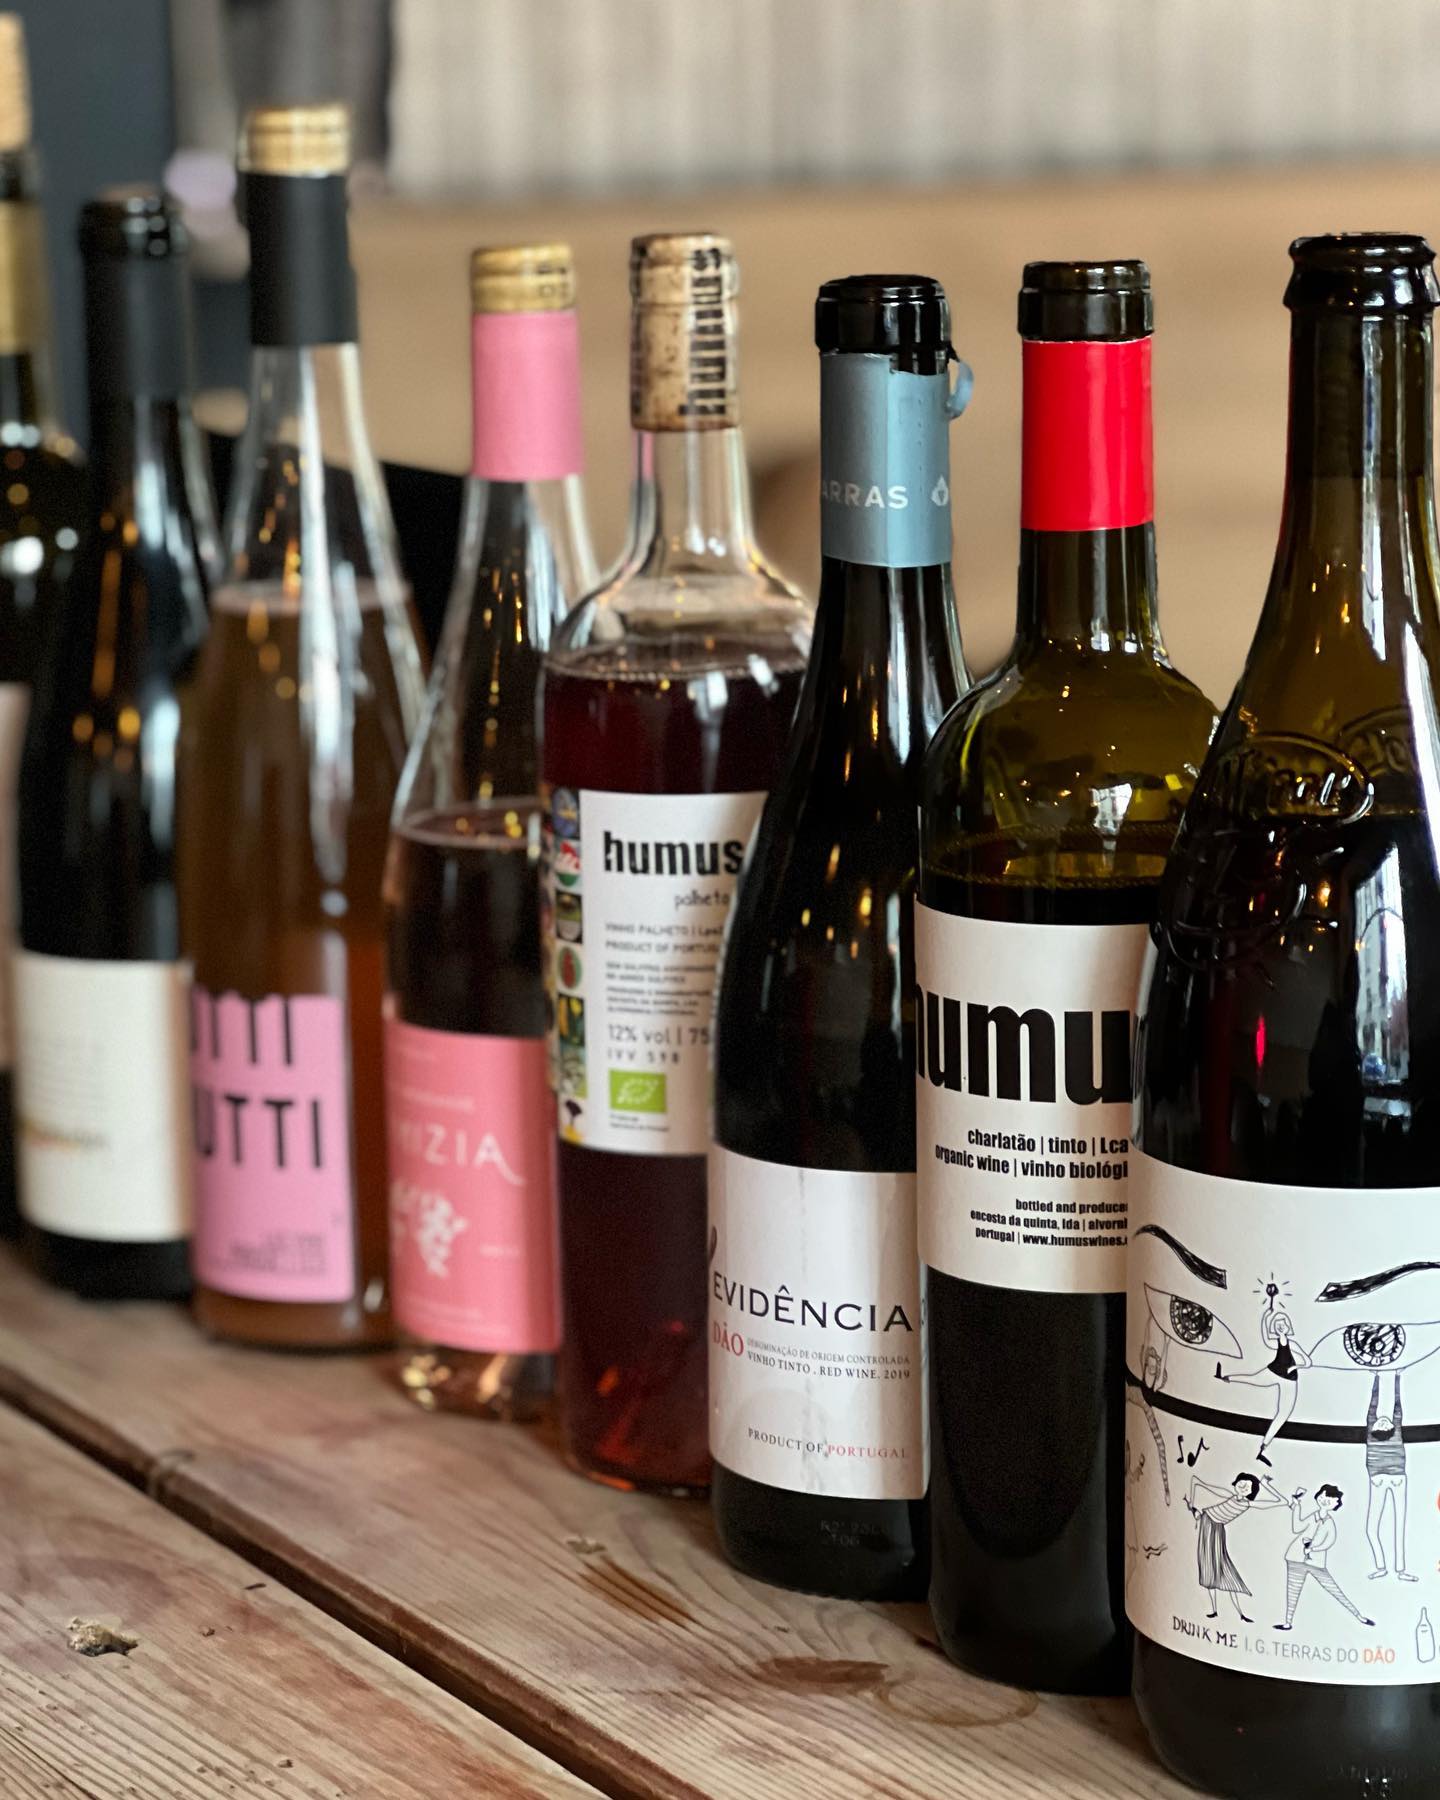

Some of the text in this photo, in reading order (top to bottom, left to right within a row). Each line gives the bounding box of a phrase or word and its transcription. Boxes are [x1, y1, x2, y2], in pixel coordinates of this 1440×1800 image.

[603, 829, 745, 875] humus
[643, 1027, 670, 1045] vol
[967, 1129, 1036, 1152] charlatão
[1048, 1137, 1087, 1154] tinto
[935, 1144, 974, 1168] organic
[976, 1155, 1010, 1173] wine
[1021, 1160, 1066, 1178] vinho
[970, 1209, 1007, 1225] encosta
[1008, 1214, 1021, 1226] da
[1023, 1217, 1060, 1230] quinta,
[1015, 1199, 1053, 1212] bottled
[1056, 1202, 1076, 1213] and
[975, 1227, 1015, 1243] portugal
[713, 1271, 913, 1333] EVIDÊNCIA
[746, 1351, 776, 1366] VINHO
[777, 1359, 811, 1374] TINTO
[819, 1367, 842, 1377] RED
[884, 1369, 910, 1380] 2019
[800, 1350, 810, 1360] DE
[811, 1352, 845, 1363] ORIGEM
[846, 1355, 911, 1365] CONTROLADA
[748, 1428, 906, 1459] PRODUCT OF PORTUGAL
[1172, 1616, 1212, 1643] DRINK
[1215, 1630, 1239, 1648] ME
[1272, 1641, 1332, 1662] TERRAS
[1336, 1648, 1359, 1663] DO
[1362, 1645, 1396, 1664] DÃO
